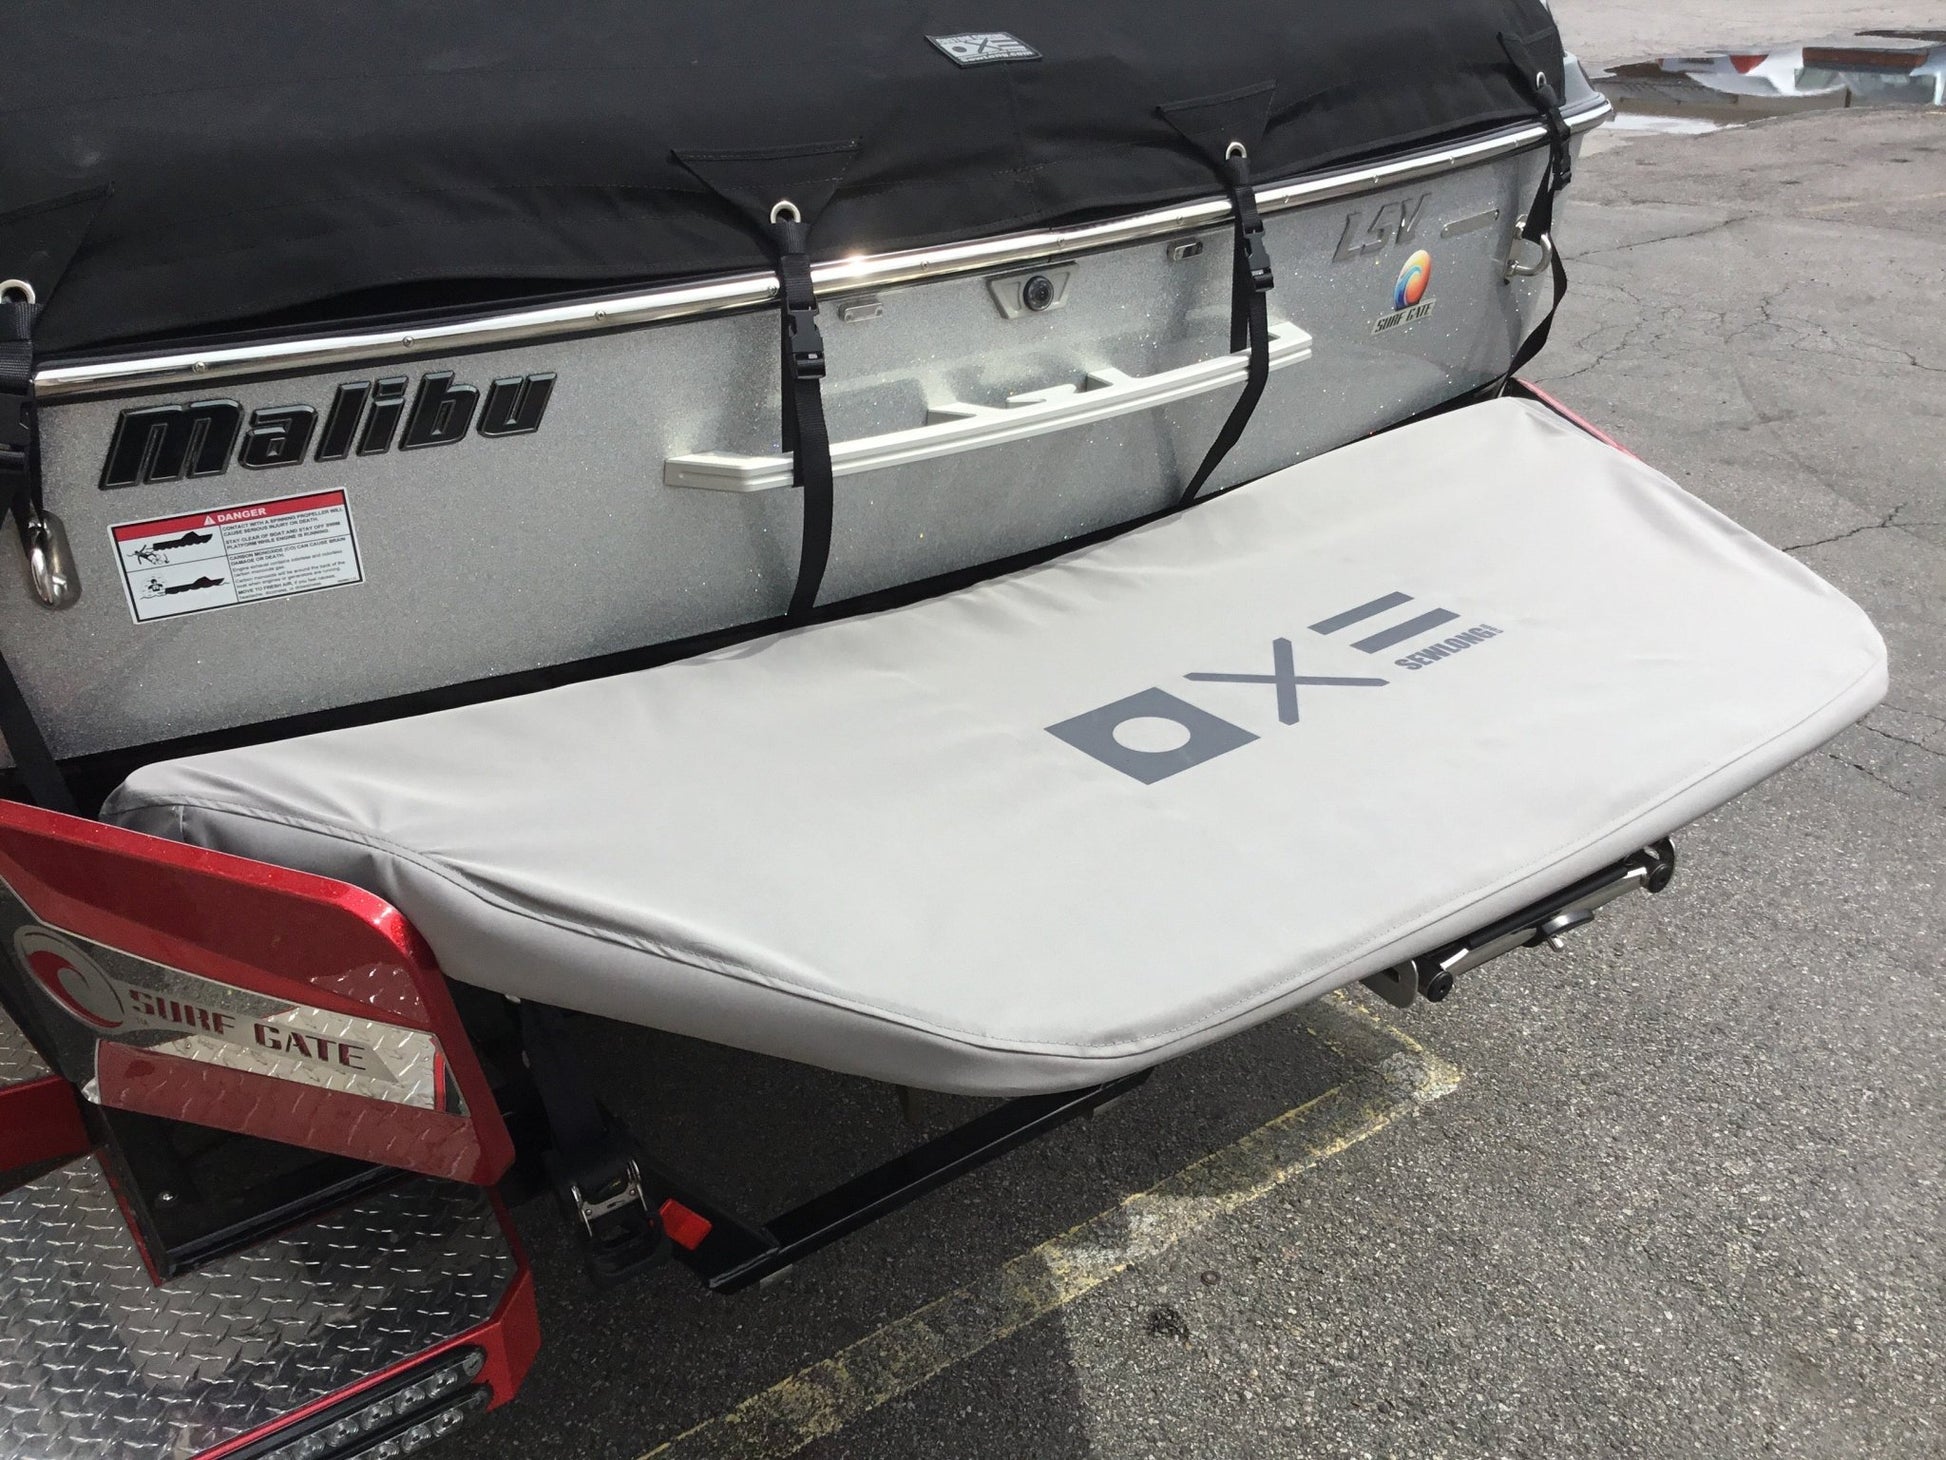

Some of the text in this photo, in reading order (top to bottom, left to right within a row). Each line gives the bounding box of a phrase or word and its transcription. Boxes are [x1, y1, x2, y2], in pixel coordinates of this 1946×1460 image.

[1332, 192, 1432, 264] LSV
[1375, 302, 1433, 333] SURF GATE
[217, 507, 267, 522] DANGER
[222, 523, 248, 531] CONTACT
[129, 989, 367, 1071] SURF GATE
